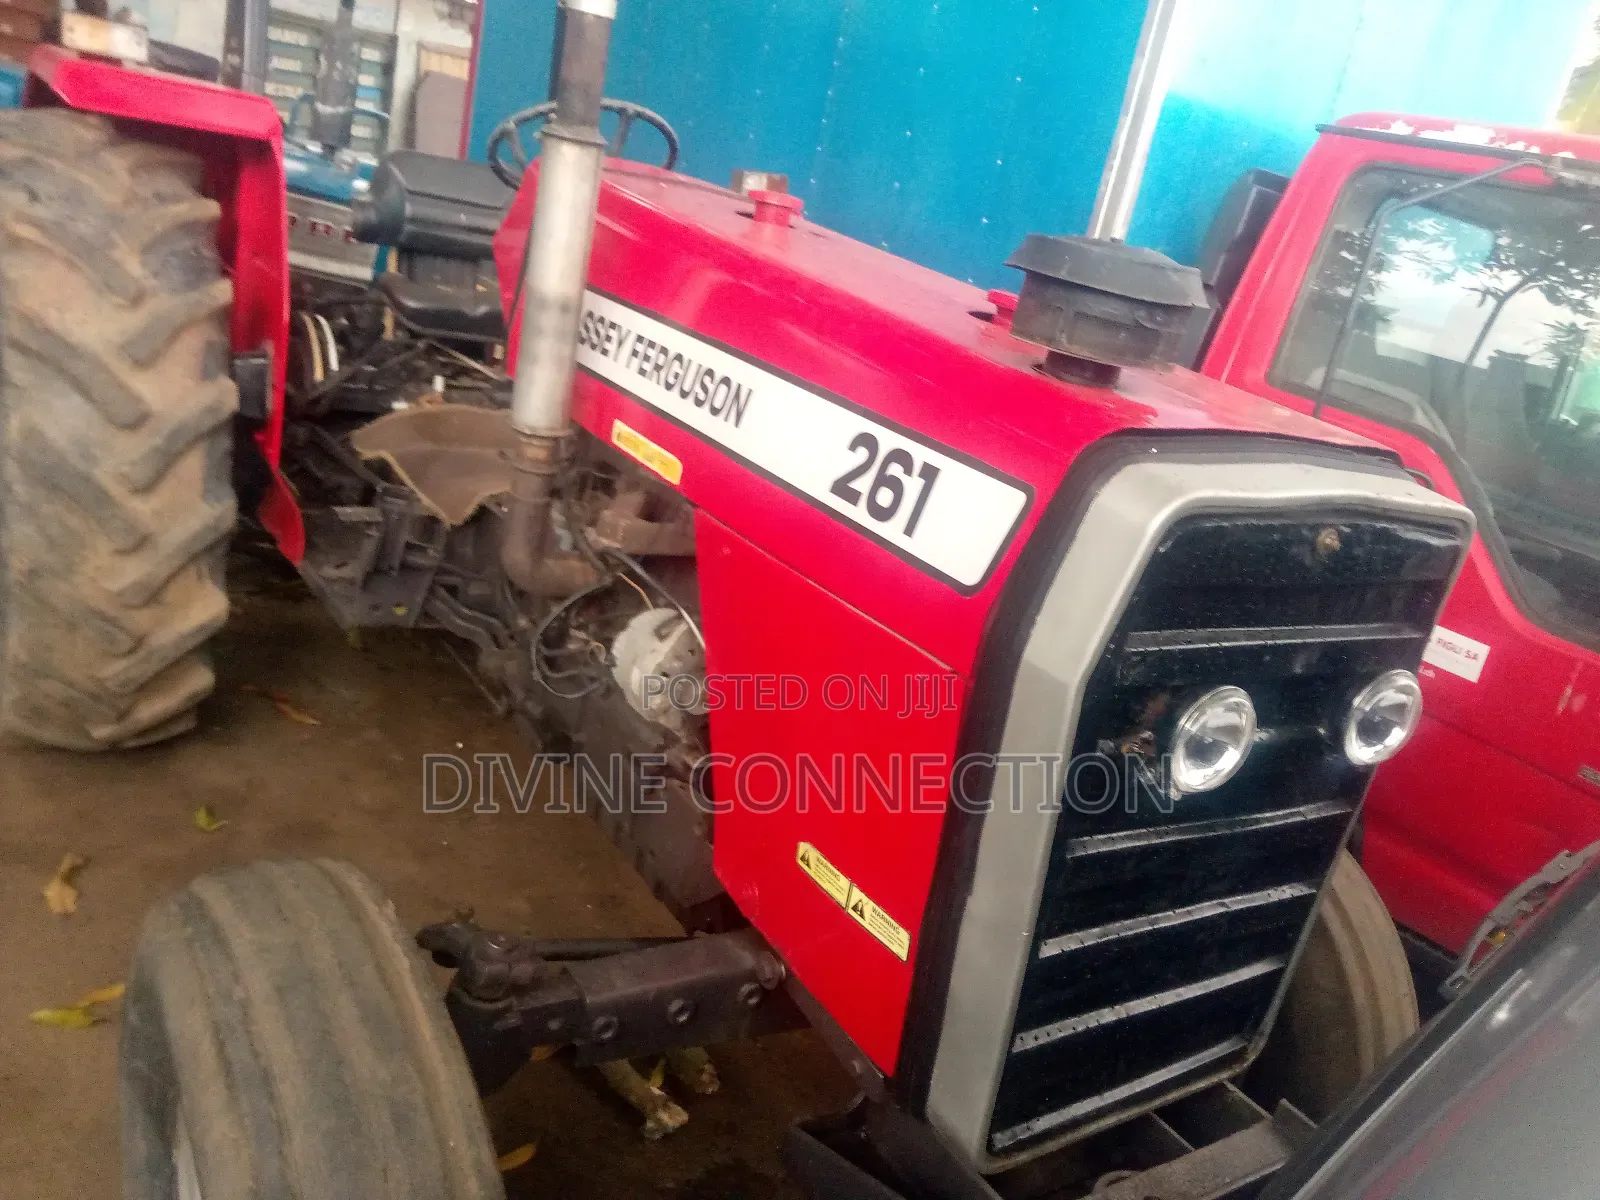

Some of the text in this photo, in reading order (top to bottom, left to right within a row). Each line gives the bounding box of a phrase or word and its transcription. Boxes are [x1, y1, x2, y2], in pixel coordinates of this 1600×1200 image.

[578, 309, 755, 428] SSEY FERGUSON
[829, 431, 942, 539] 261
[816, 856, 842, 882] WARNING
[871, 905, 901, 936] WARNING
